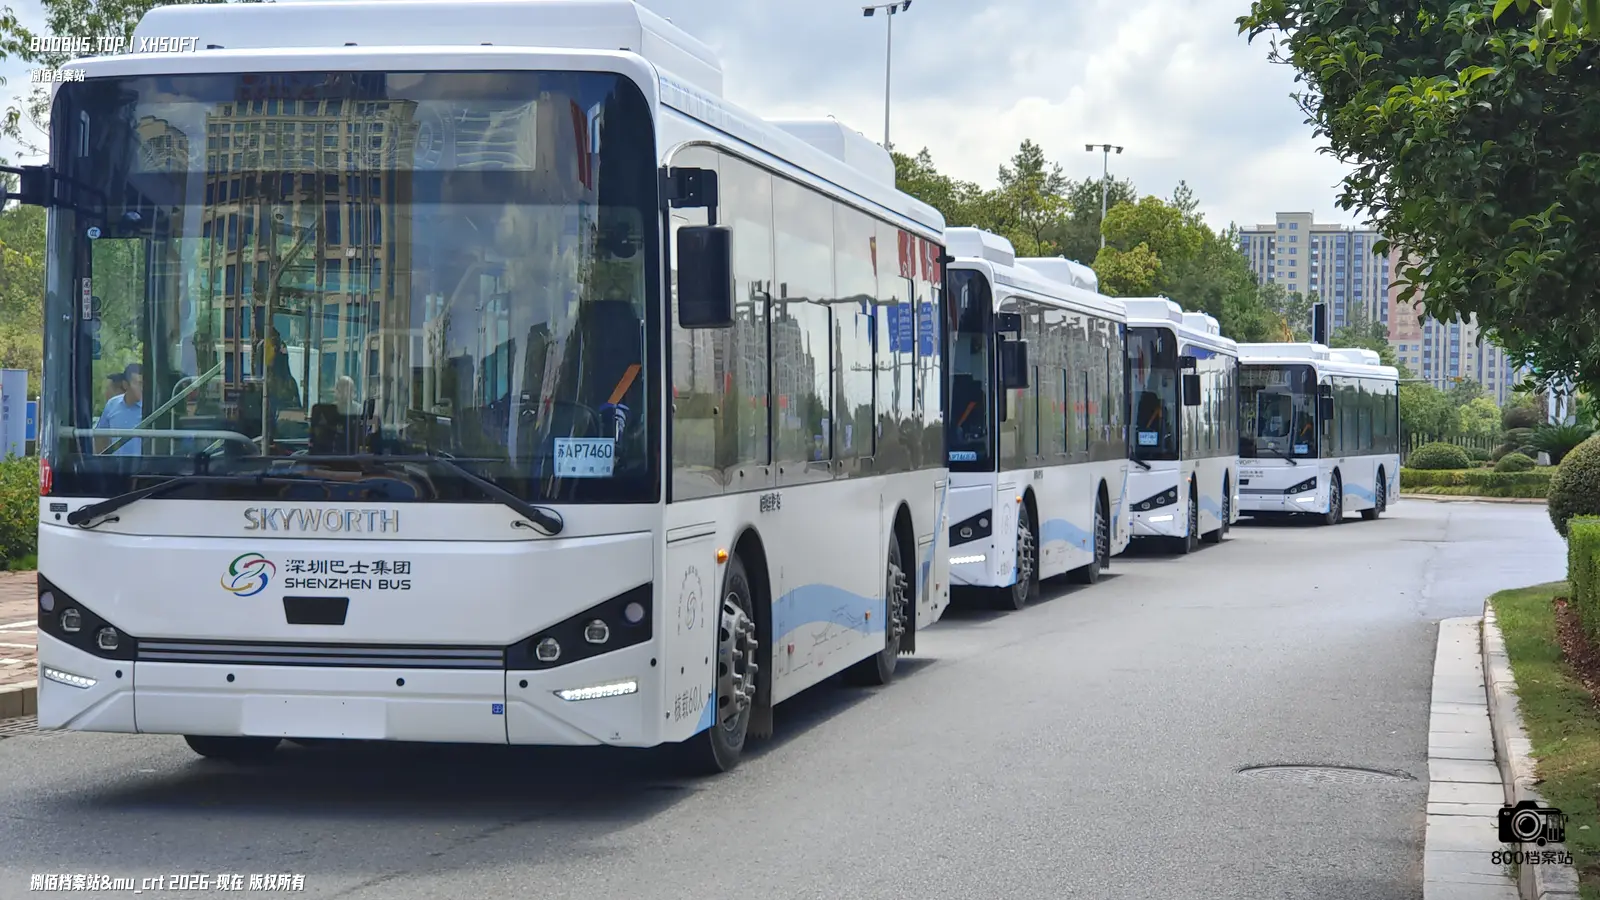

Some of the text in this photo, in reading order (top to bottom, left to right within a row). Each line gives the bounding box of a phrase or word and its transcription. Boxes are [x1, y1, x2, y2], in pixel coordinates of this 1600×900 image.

[557, 443, 612, 459] 苏AP7460
[243, 507, 399, 533] SKYWORTH
[285, 558, 411, 576] 深圳巴士集团
[284, 577, 411, 591] SHENZHEN BUS
